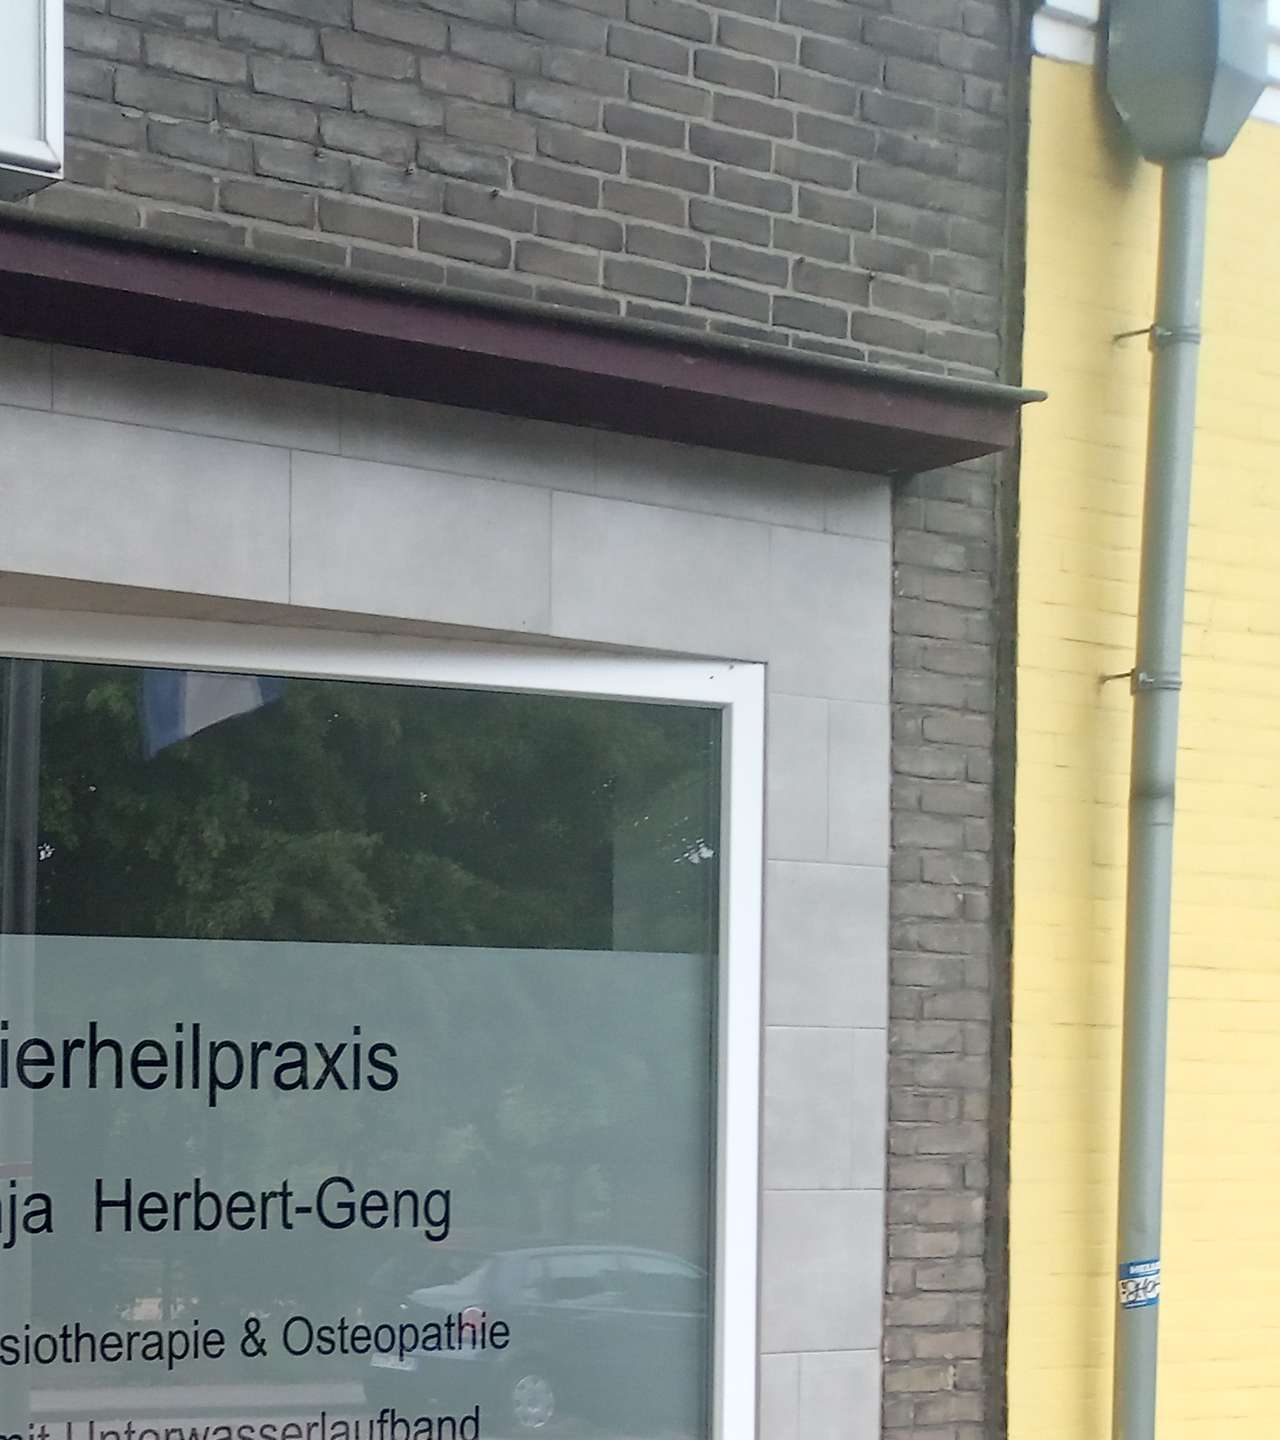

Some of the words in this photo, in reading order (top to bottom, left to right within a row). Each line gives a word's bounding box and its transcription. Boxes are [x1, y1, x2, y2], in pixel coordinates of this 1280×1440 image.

[94, 1176, 451, 1241] Herbert-Geng
[241, 1317, 267, 1356] &
[282, 1309, 510, 1358] Osteopathie
